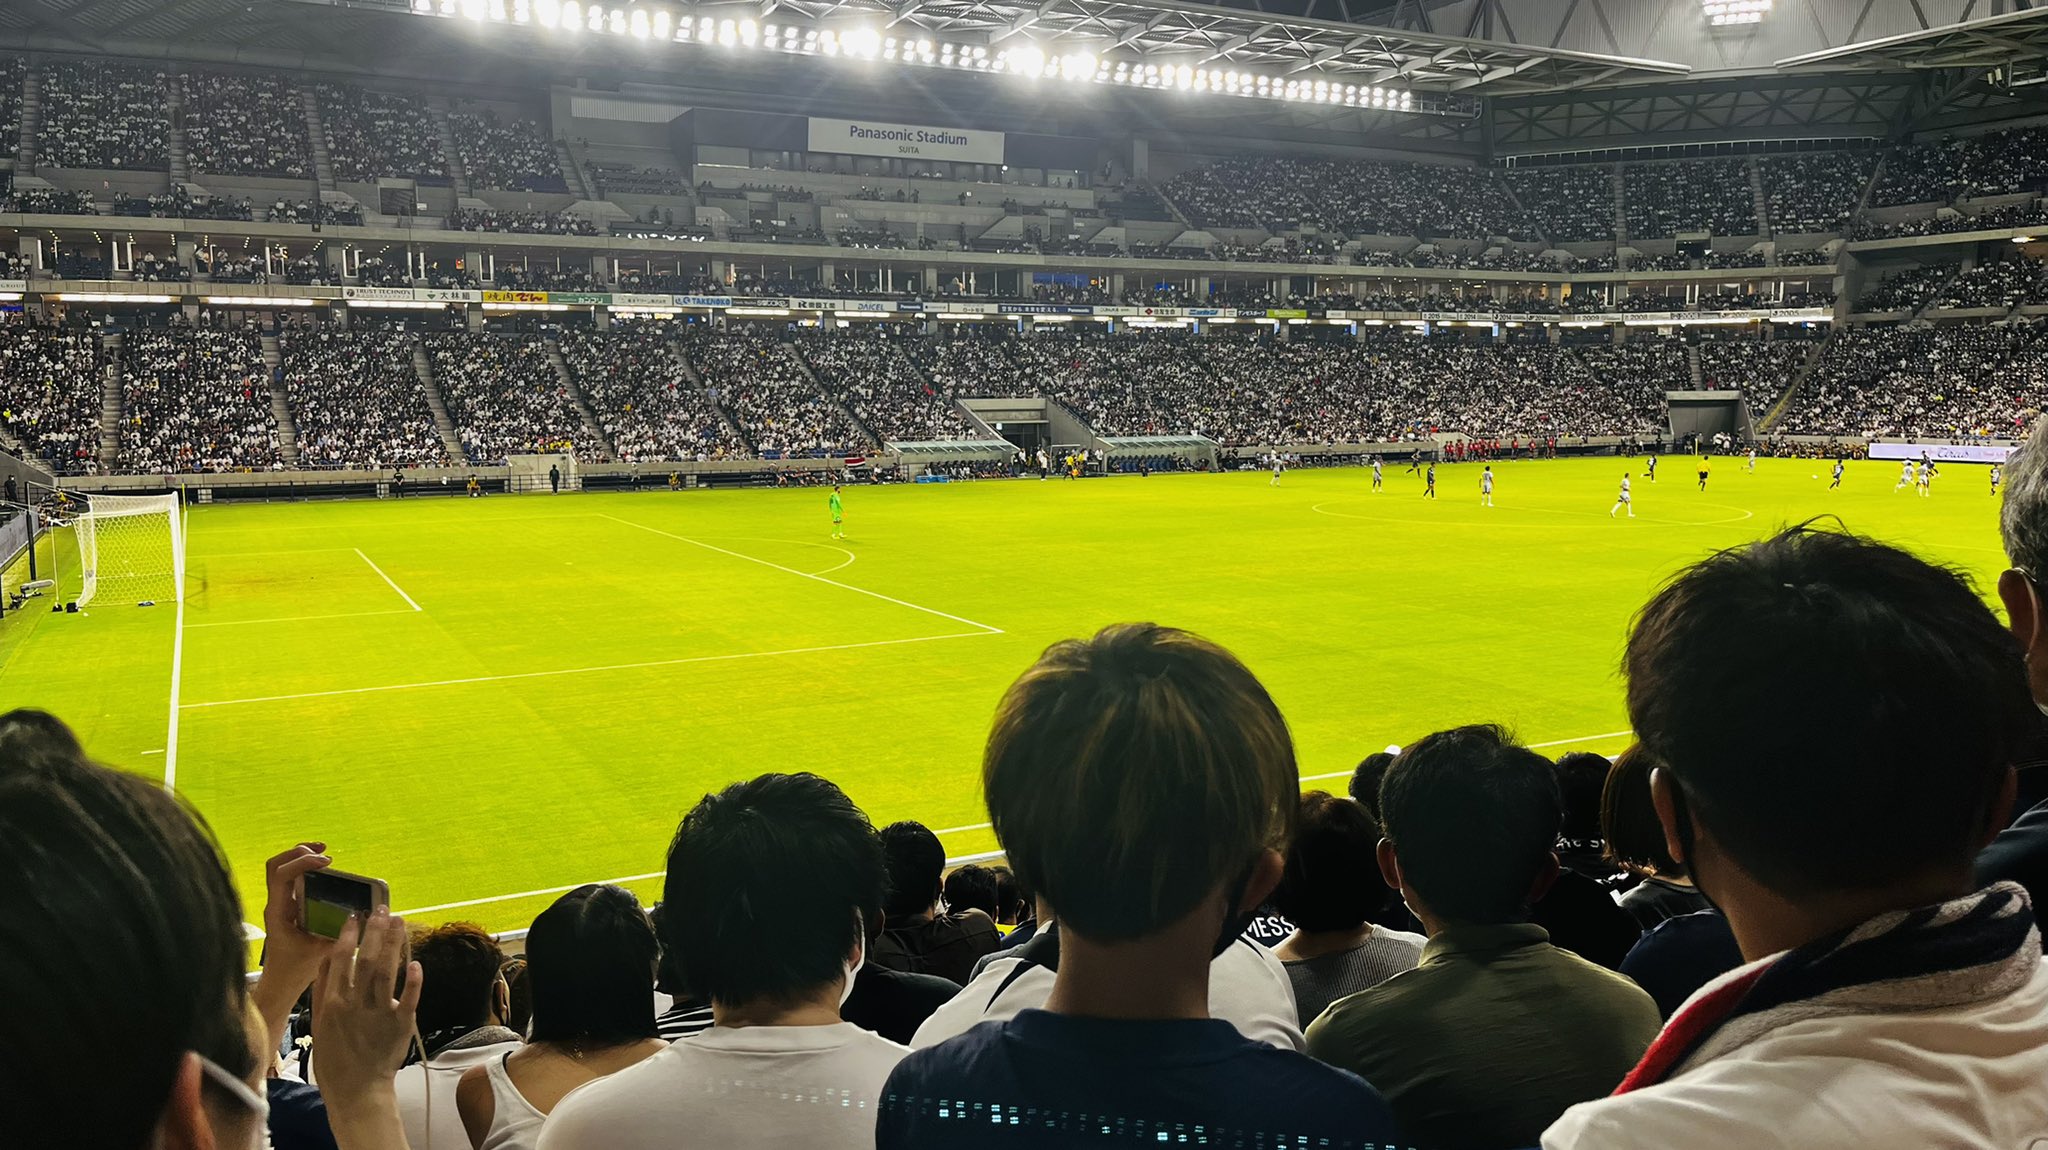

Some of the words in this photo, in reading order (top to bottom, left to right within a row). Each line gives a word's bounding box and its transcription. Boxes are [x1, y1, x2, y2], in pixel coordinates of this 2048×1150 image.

[850, 125, 914, 142] Panasonic
[916, 130, 968, 146] Stadium
[898, 146, 920, 154] SUITA
[691, 297, 731, 307] TAKENOKO
[857, 303, 884, 311] DAICEL
